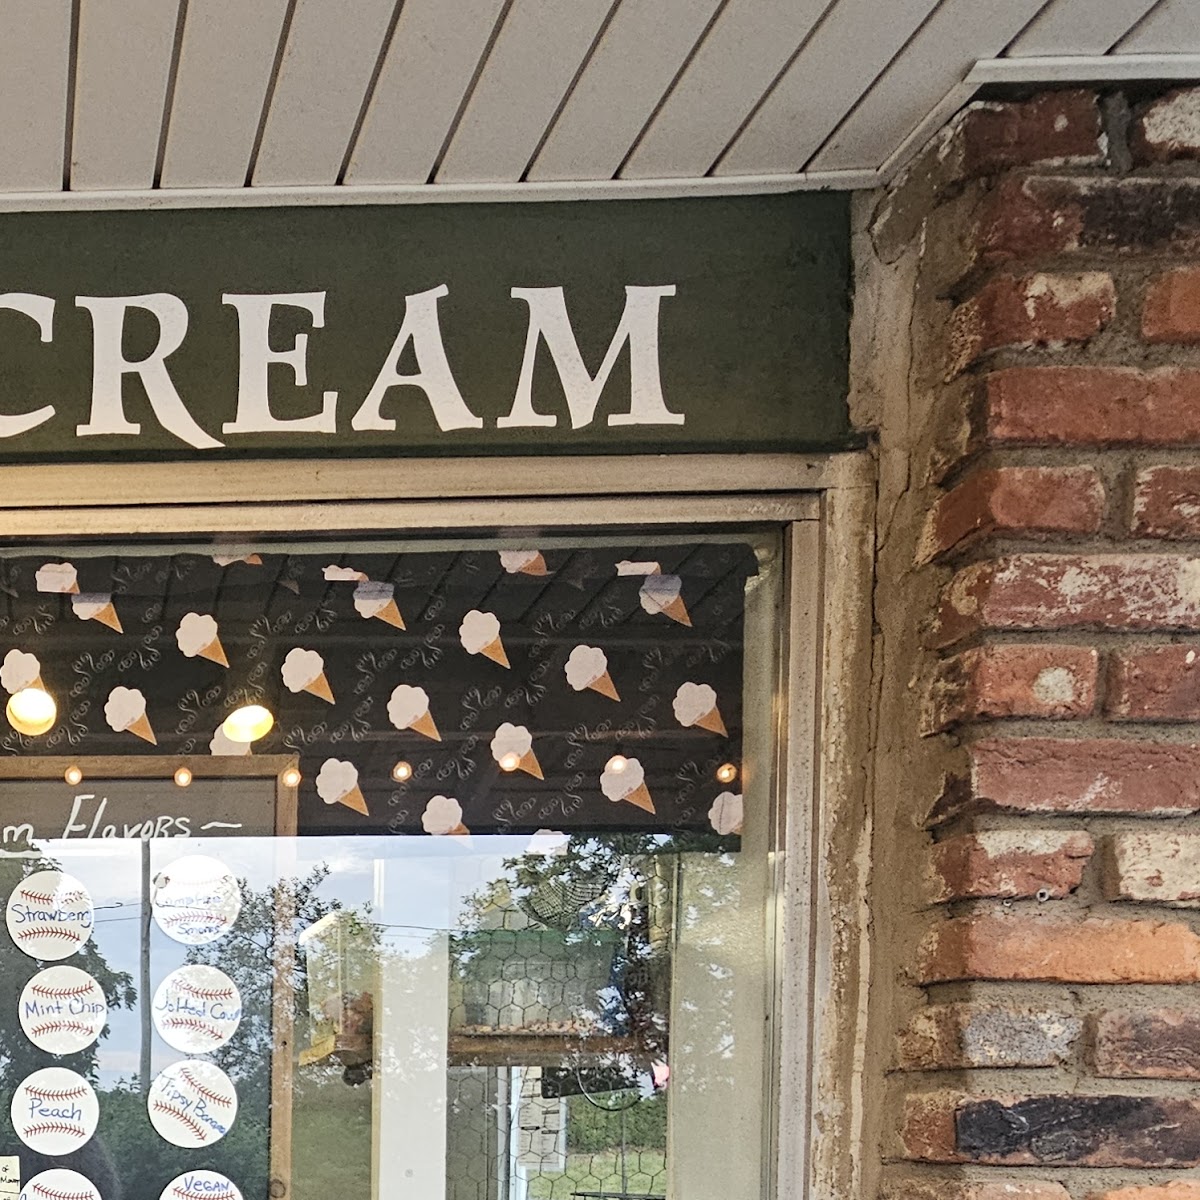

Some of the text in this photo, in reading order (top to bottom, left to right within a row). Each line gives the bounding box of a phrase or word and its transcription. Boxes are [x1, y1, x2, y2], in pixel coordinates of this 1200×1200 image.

[25, 997, 105, 1019] Mint Chip
[161, 1074, 194, 1113] Tipsy
[28, 1097, 82, 1121] Peach
